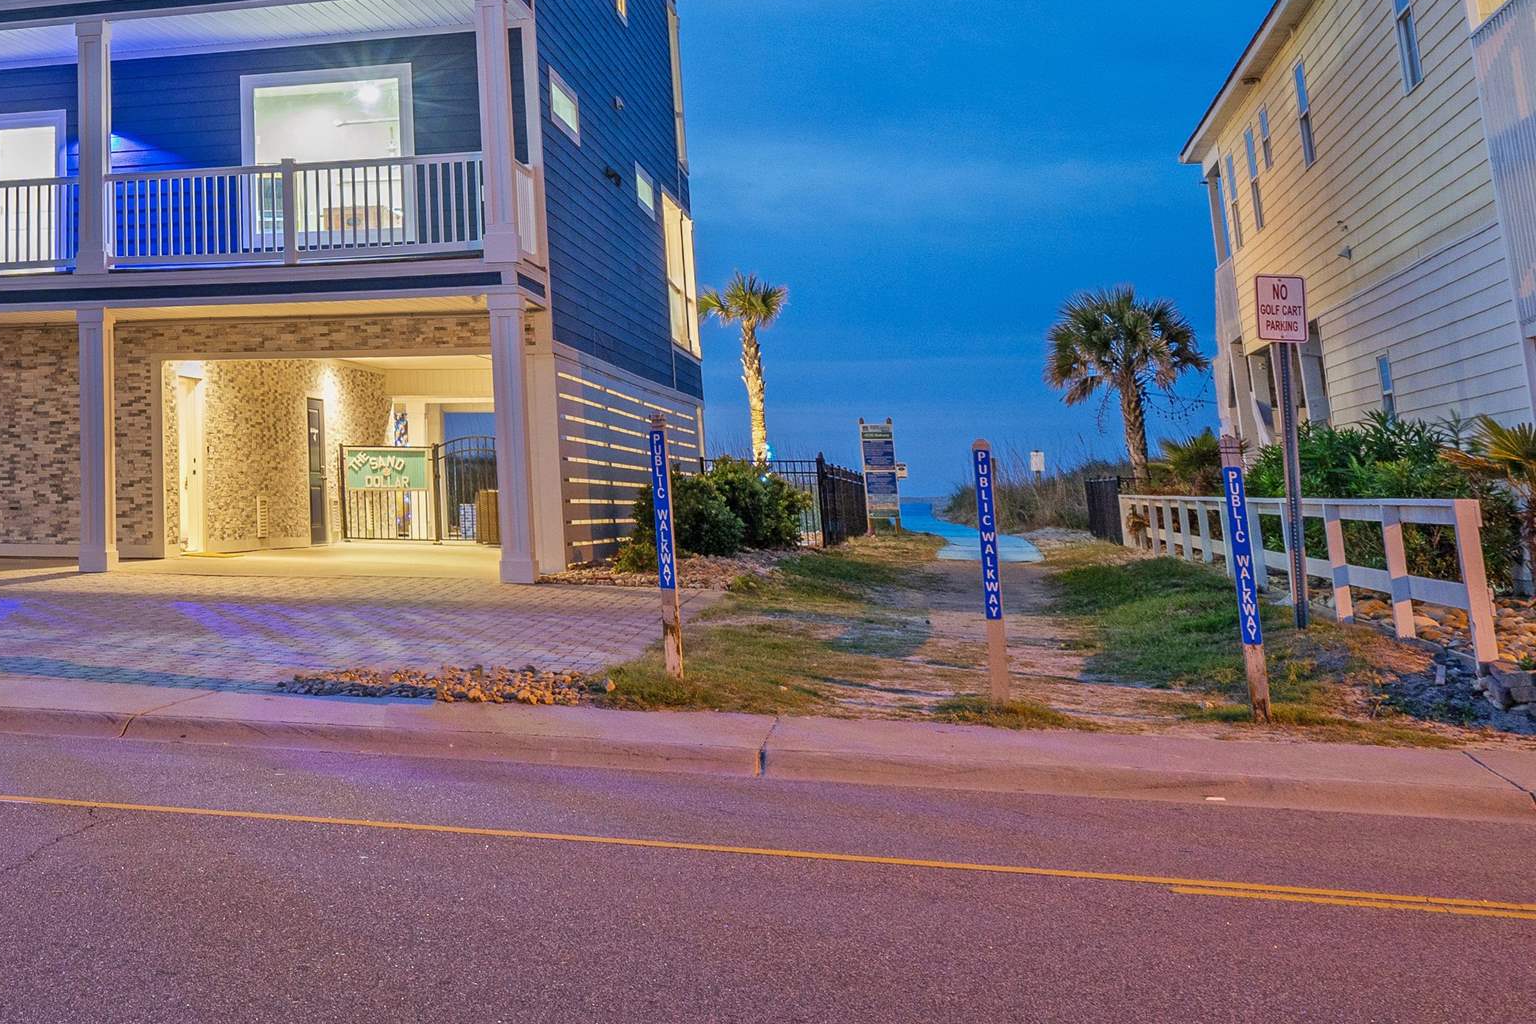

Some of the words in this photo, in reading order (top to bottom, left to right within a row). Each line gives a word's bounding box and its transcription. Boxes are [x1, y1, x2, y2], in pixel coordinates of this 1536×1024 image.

[1260, 304, 1280, 315] GOLF
[1282, 305, 1302, 316] CART
[1272, 283, 1288, 300] NO
[1266, 320, 1298, 332] PARKING
[349, 451, 370, 471] THE
[369, 455, 405, 471] SAND
[366, 476, 410, 488] DOLLAR
[653, 434, 665, 499] PUBLIC
[977, 451, 992, 526] PUBLIC
[1228, 471, 1246, 543] PUBLIC
[657, 509, 671, 586] WALKWAY
[982, 532, 999, 617] WALKWAY
[1236, 554, 1257, 640] WALKWAY
